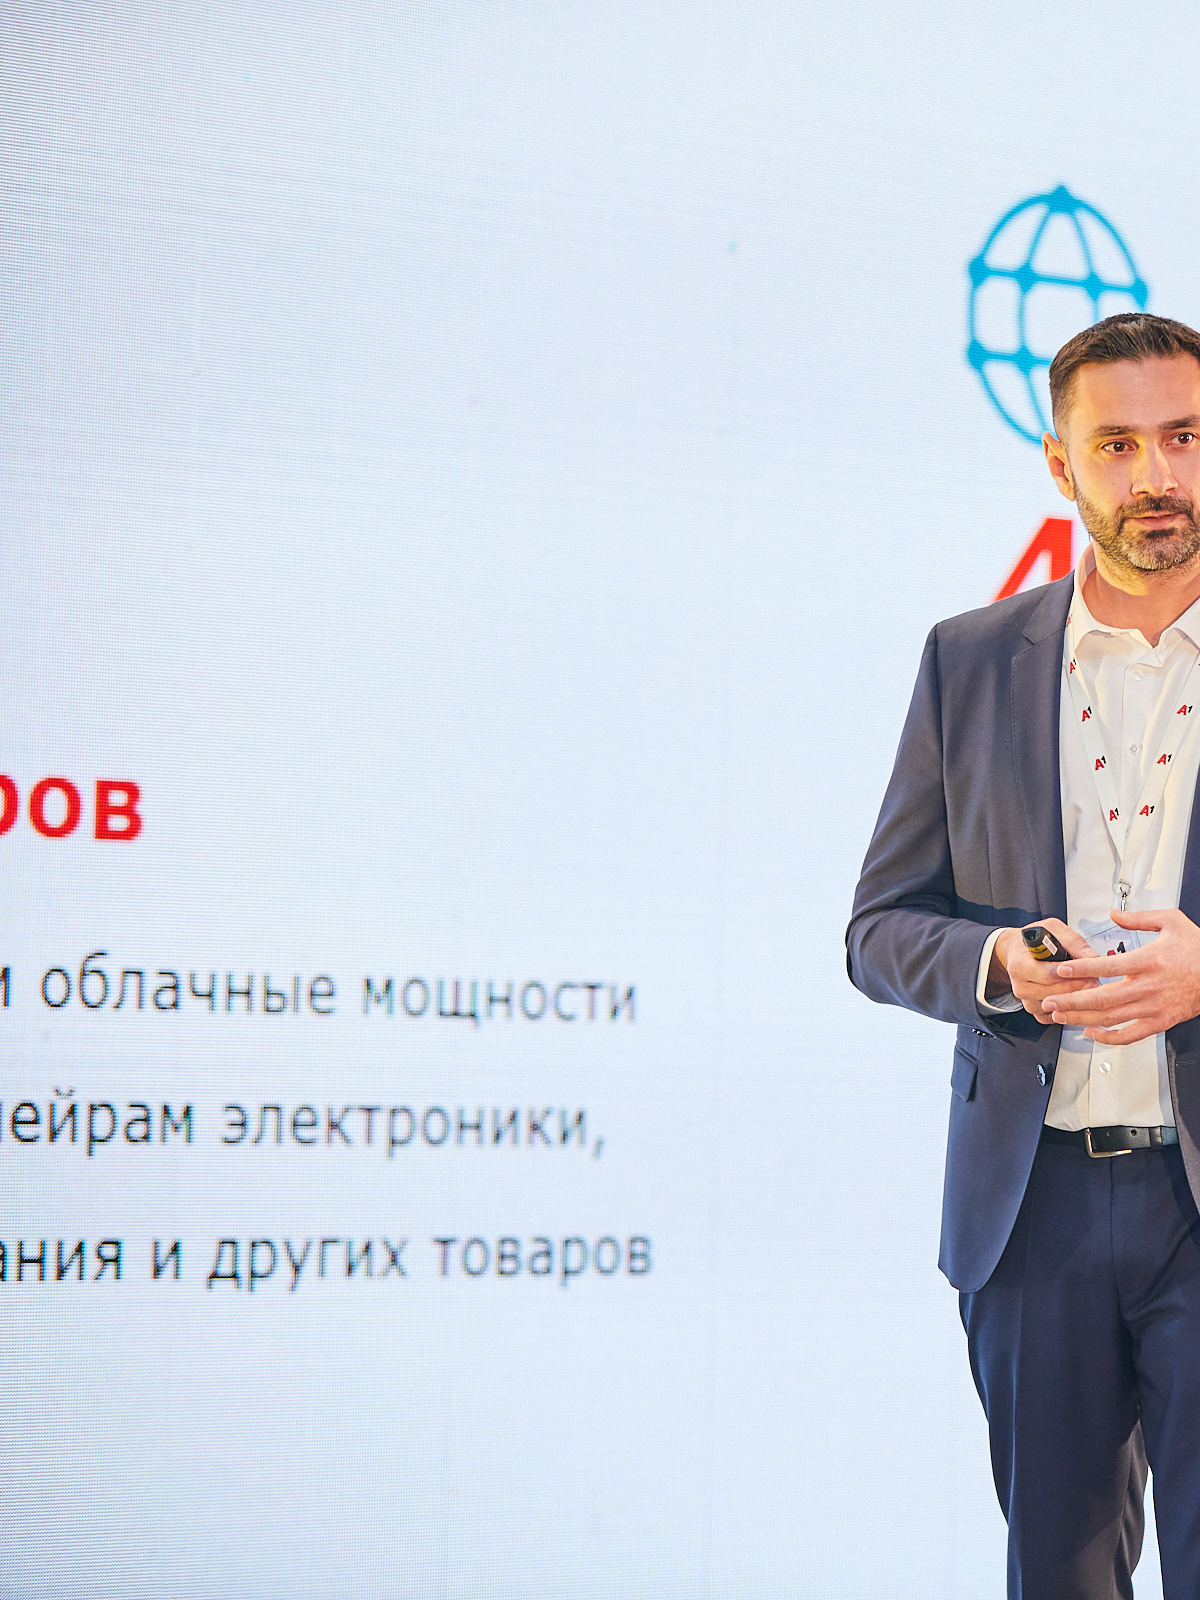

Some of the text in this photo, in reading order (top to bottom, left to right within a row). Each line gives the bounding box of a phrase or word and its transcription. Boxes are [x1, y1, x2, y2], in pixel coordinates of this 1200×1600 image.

[1081, 705, 1093, 722] A1
[1176, 704, 1193, 716] A1
[1094, 755, 1107, 771] A1
[1156, 753, 1172, 765] A1
[1109, 807, 1119, 821] A1
[1139, 804, 1155, 817] A1
[40, 949, 337, 1016] облачные
[362, 976, 638, 1028] мощности
[0, 1088, 606, 1160] ейрам электроники,
[0, 1235, 654, 1292] ния и других товаров
